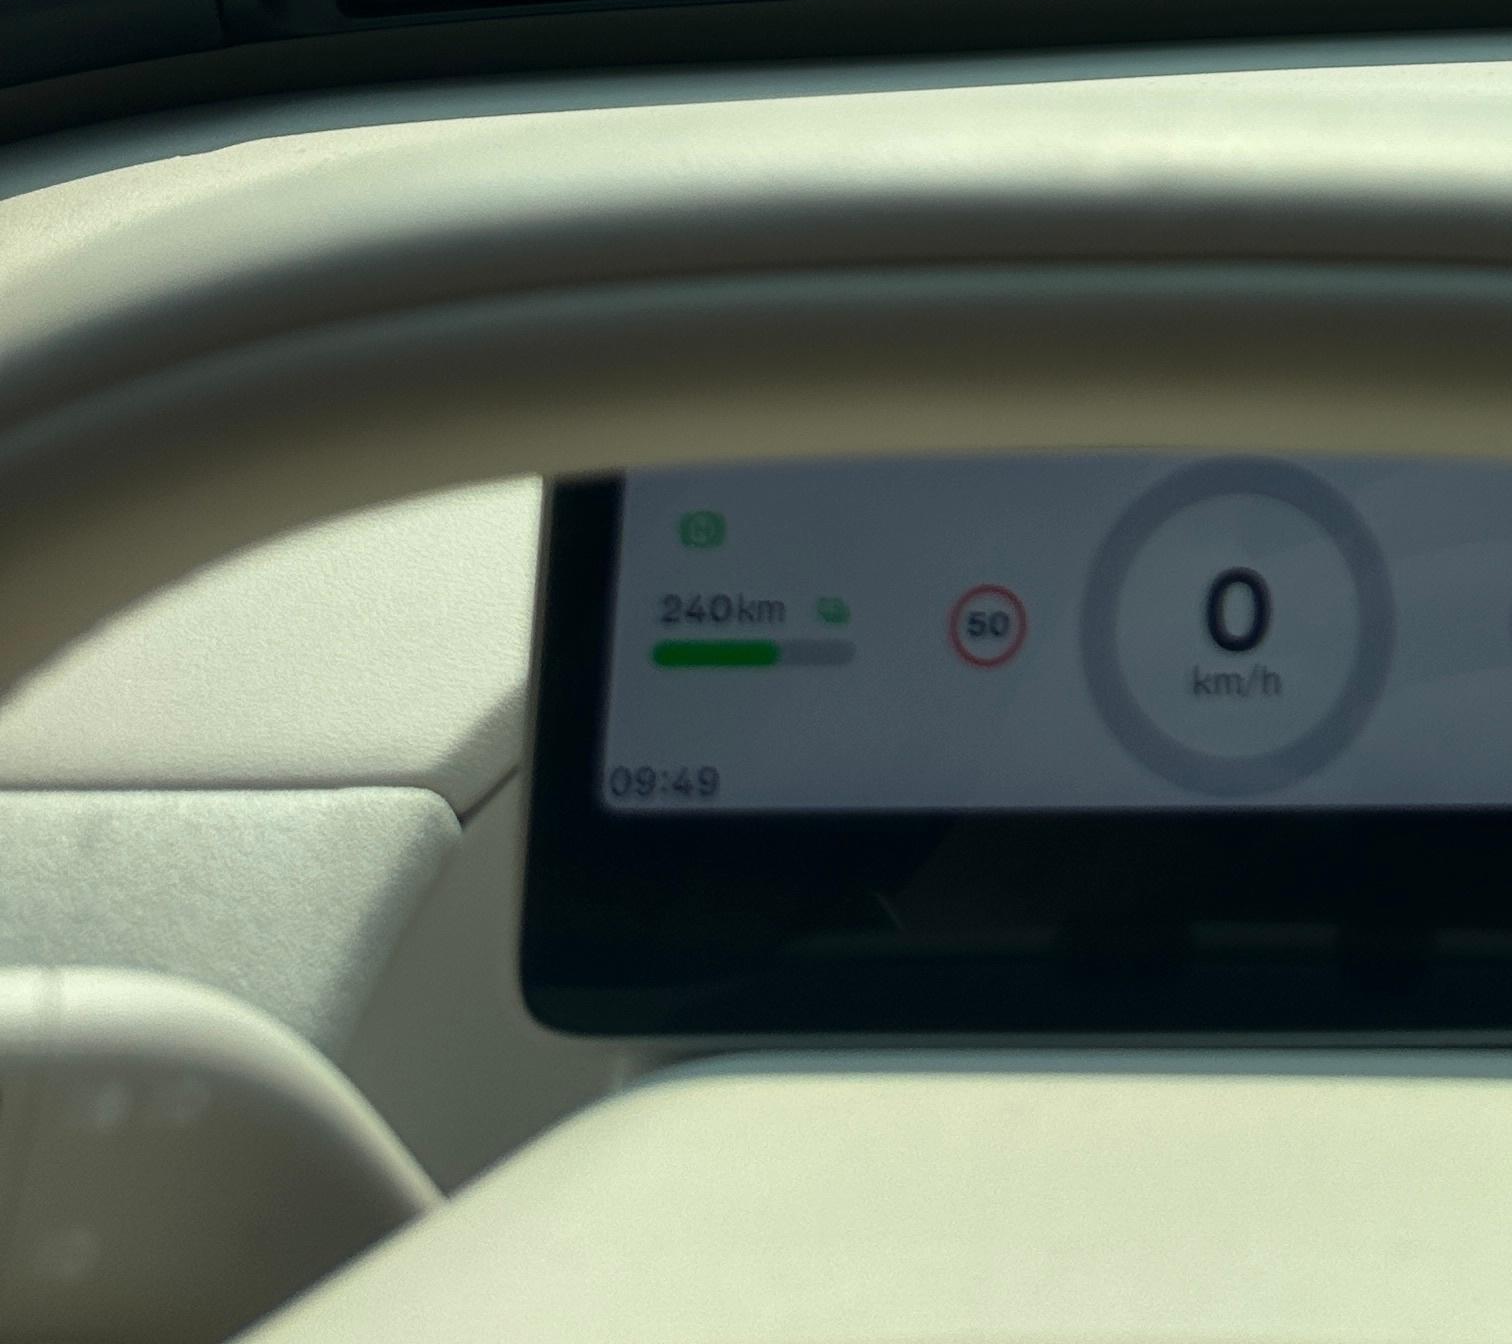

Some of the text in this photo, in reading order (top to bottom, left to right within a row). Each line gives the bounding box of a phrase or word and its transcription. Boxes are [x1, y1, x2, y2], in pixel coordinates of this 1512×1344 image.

[967, 613, 1011, 639] 50
[1207, 567, 1270, 654] 0
[1192, 664, 1282, 698] km/h
[610, 766, 720, 798] 09:49
